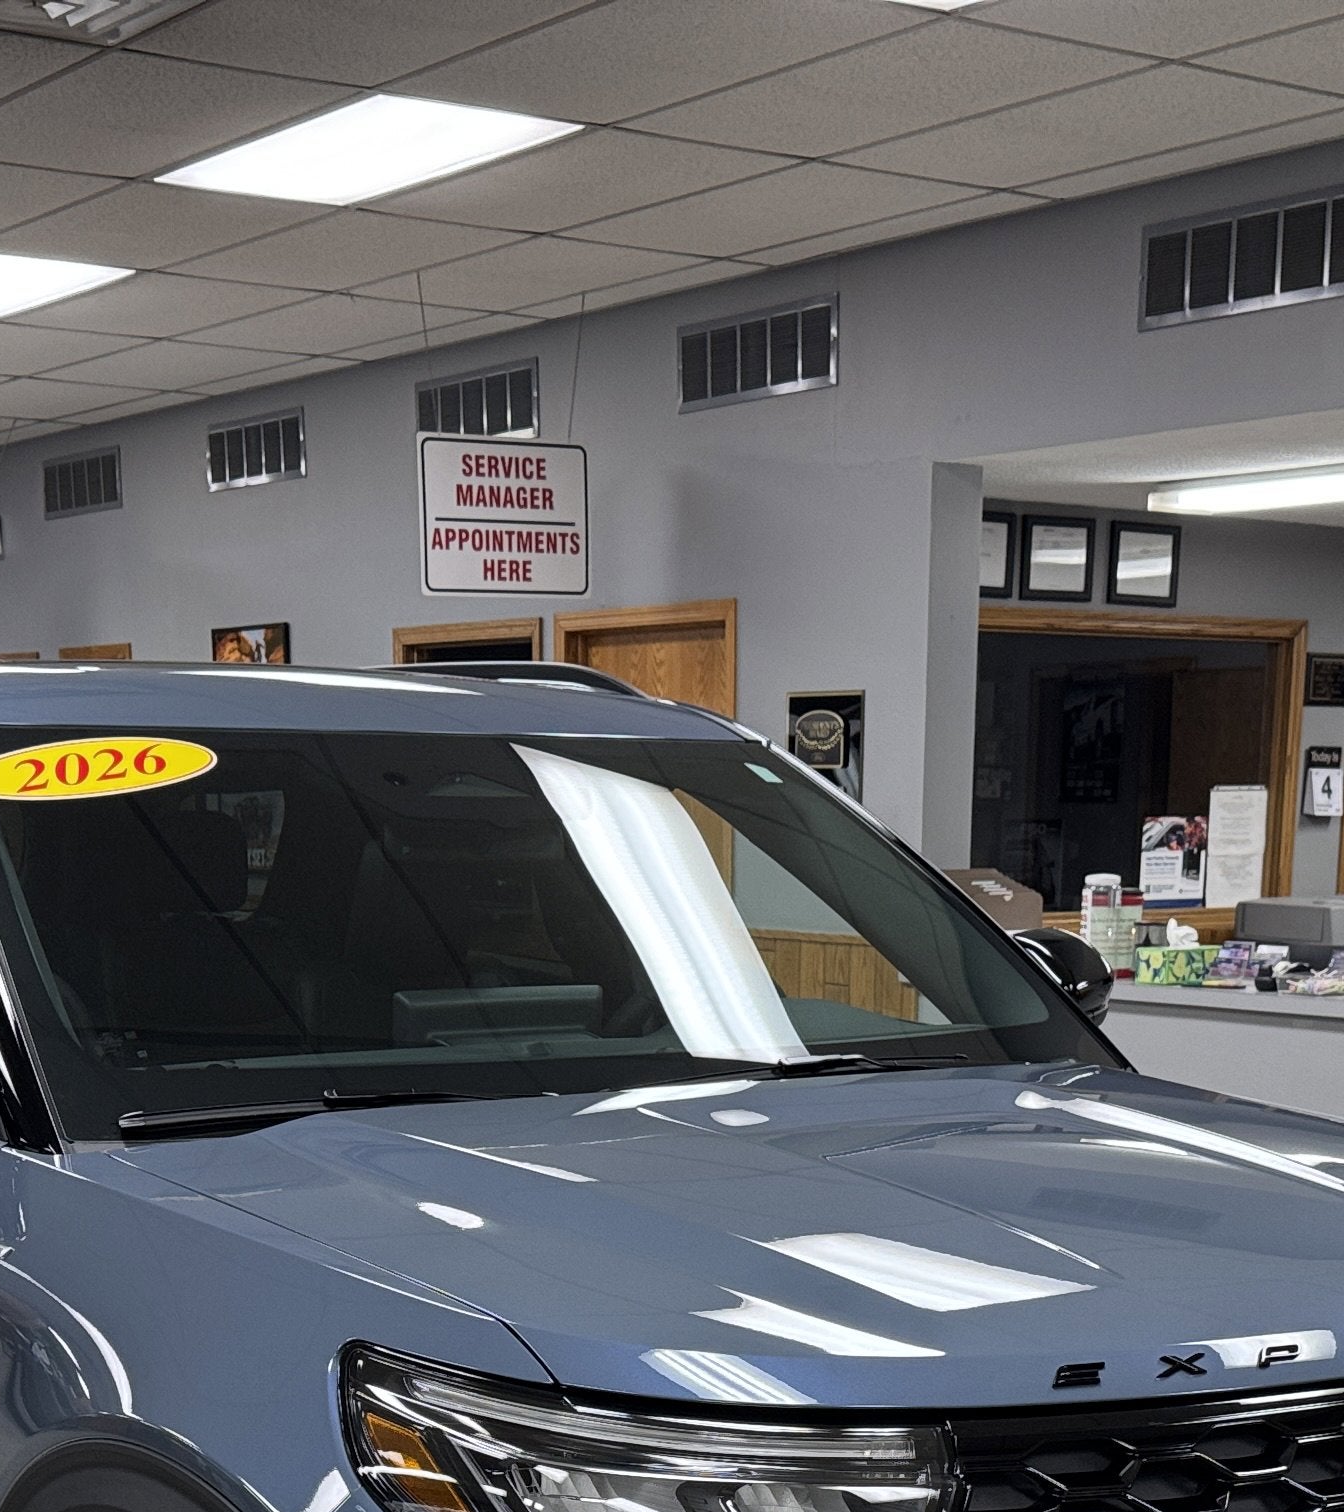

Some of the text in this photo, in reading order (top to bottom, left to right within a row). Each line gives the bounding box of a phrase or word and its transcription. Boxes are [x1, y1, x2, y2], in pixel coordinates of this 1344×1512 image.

[461, 453, 547, 480] SERVICE
[455, 484, 554, 510] MANAGER
[431, 527, 580, 555] APPOINTMENTS
[483, 558, 532, 582] HERE
[13, 743, 167, 794] 2026
[1321, 775, 1333, 800] 4
